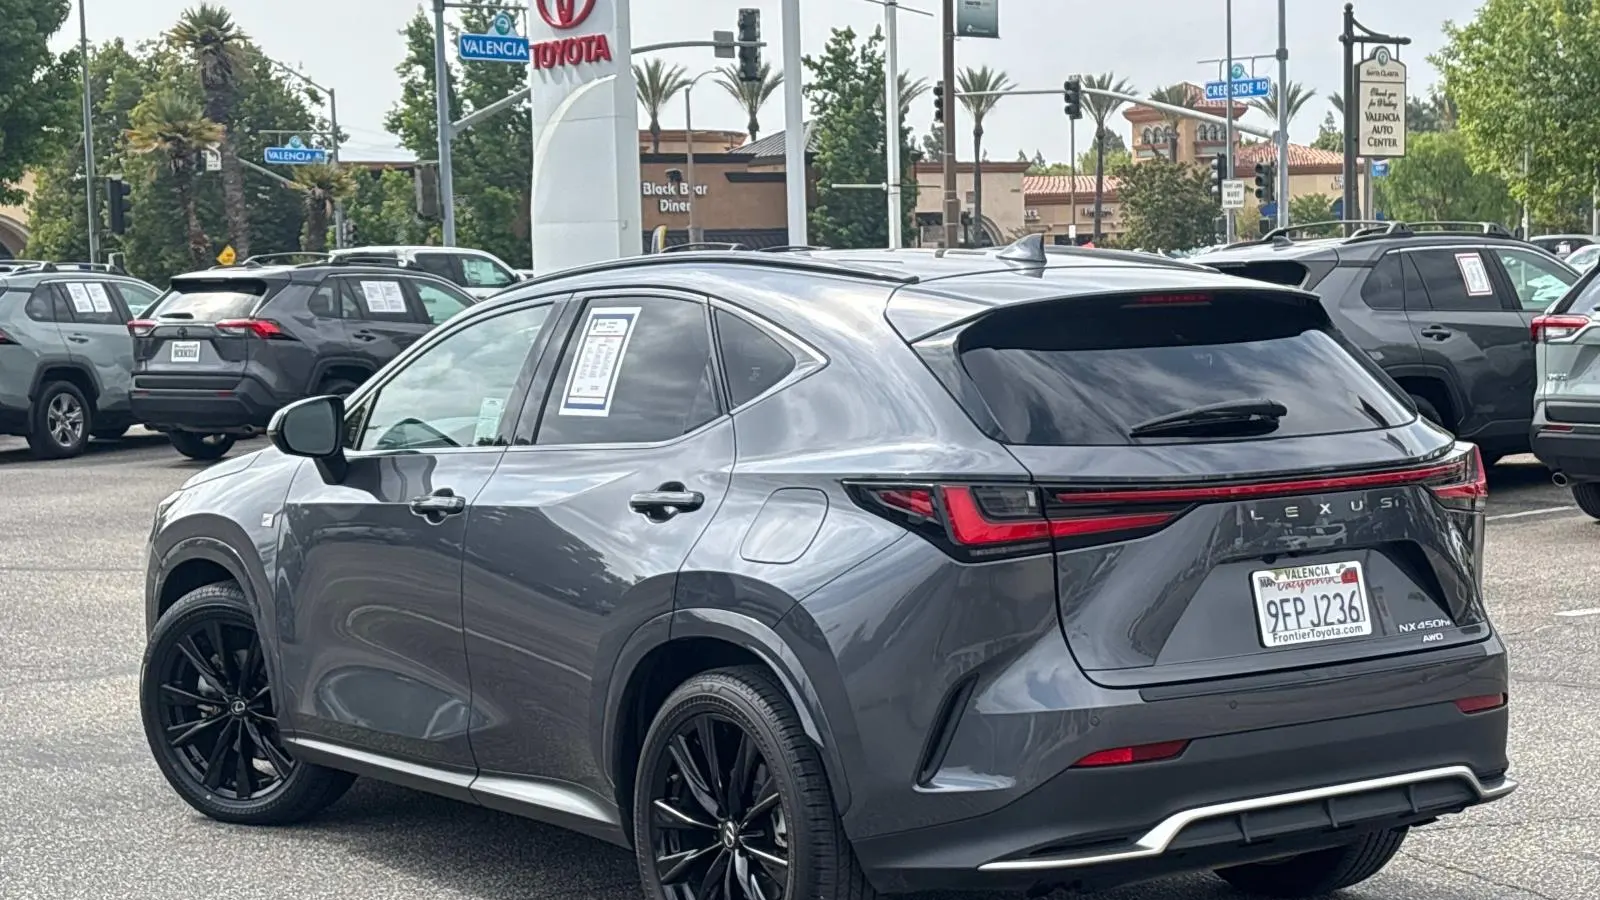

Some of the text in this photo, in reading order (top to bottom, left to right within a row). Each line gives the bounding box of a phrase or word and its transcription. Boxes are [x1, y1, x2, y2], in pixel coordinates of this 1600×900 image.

[462, 38, 527, 57] VALENCIA
[530, 34, 612, 70] TOYOTA
[1206, 81, 1268, 97] CREESIDE RD
[1365, 111, 1401, 122] VALENCIA
[1371, 125, 1393, 135] AUTO
[1367, 136, 1398, 147] CENTER
[268, 151, 312, 161] VALENCIA
[643, 182, 708, 195] Black Bar
[660, 199, 691, 212] Diner
[1250, 496, 1393, 521] LEXUS
[1284, 566, 1331, 580] VALENCIA
[1272, 625, 1364, 644] FrontierToyota.com
[1423, 632, 1444, 643] AWD
